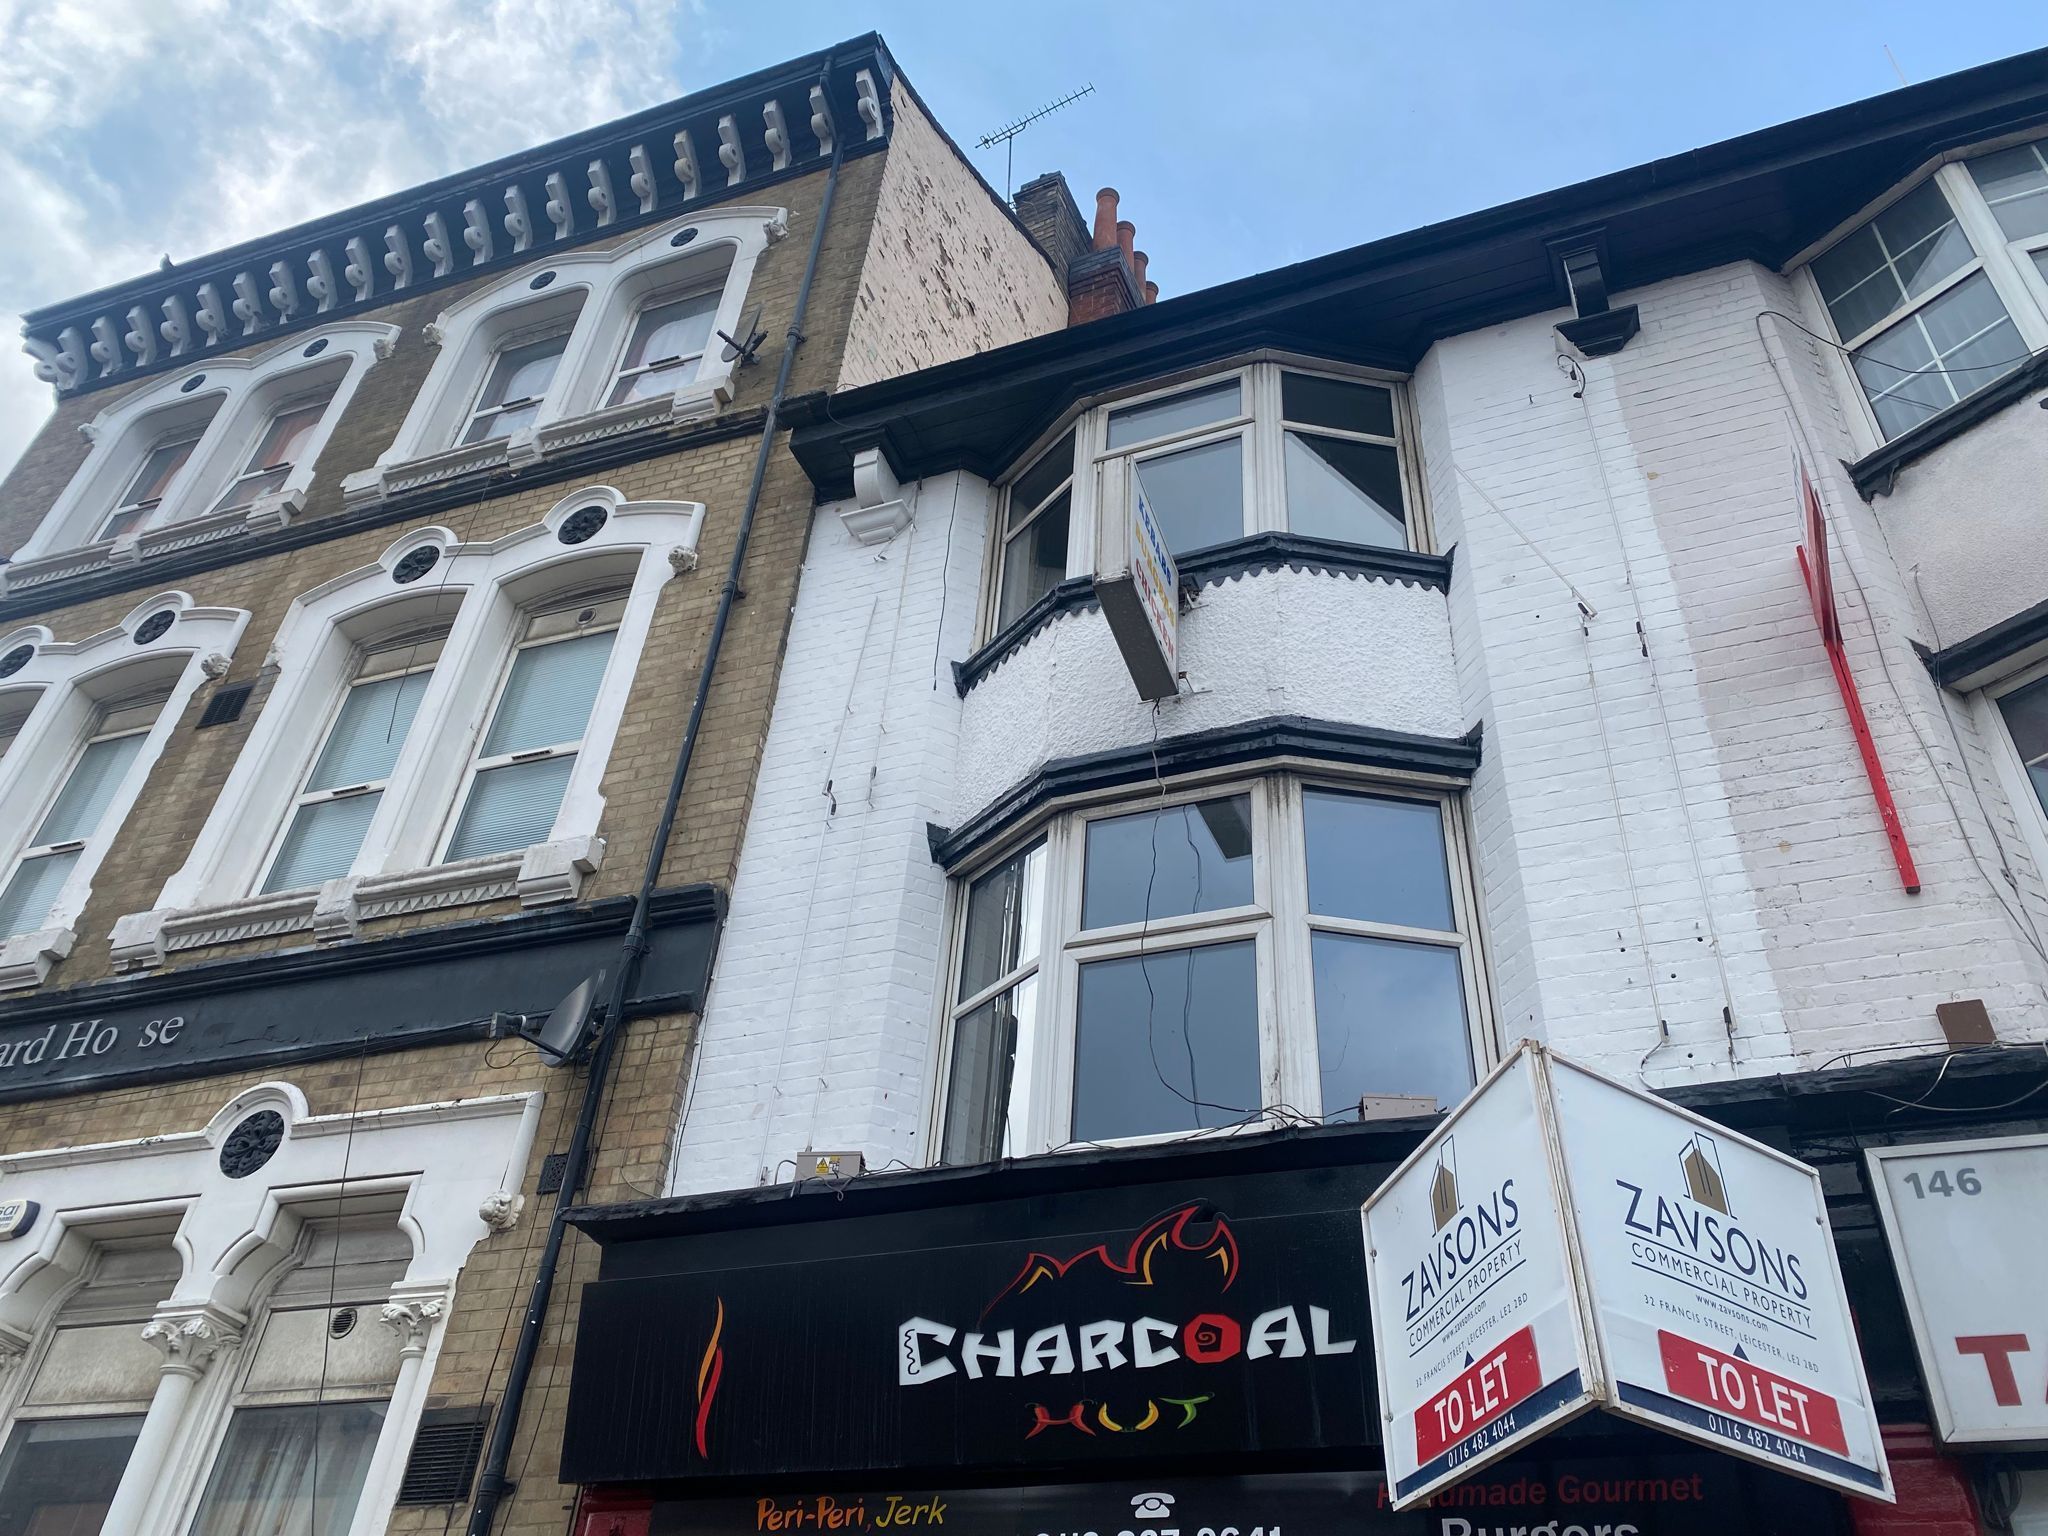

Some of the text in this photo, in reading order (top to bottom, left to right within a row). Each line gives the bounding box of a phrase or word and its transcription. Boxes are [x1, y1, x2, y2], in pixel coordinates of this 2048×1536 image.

[1138, 493, 1172, 587] KEBABS
[1135, 558, 1174, 661] CHICKEN
[1903, 1167, 1983, 1200] 146
[1401, 1178, 1519, 1323] ZAVSONS
[1616, 1178, 1808, 1301] ZAVSONS
[1409, 1239, 1521, 1347] COMMERCIAL PROPERTY
[1441, 1299, 1488, 1344] www.zavsons.com
[1631, 1242, 1812, 1329] COMMERCIAL PROPERTY
[1695, 1294, 1769, 1332] www.zavsons.com
[899, 1304, 1358, 1386] CHARCOAL
[1423, 1359, 1446, 1382] FRANCIS
[1500, 1303, 1512, 1319] LE2
[1513, 1293, 1529, 1309] 2BD
[1643, 1294, 1656, 1307] 32
[1659, 1299, 1701, 1324] FRANCIS
[1703, 1317, 1737, 1340] STREET,
[1786, 1353, 1801, 1367] LE2
[1434, 1351, 1510, 1443] TO LET
[1697, 1352, 1811, 1437] TO LET
[1955, 1333, 2048, 1407] T
[1024, 1391, 1216, 1440] HUT
[1448, 1413, 1516, 1468] 0116 482 4044
[1708, 1414, 1807, 1464] 0116 482 4044
[875, 1495, 948, 1528] Jerk
[1557, 1473, 1704, 1505] Gourmet
